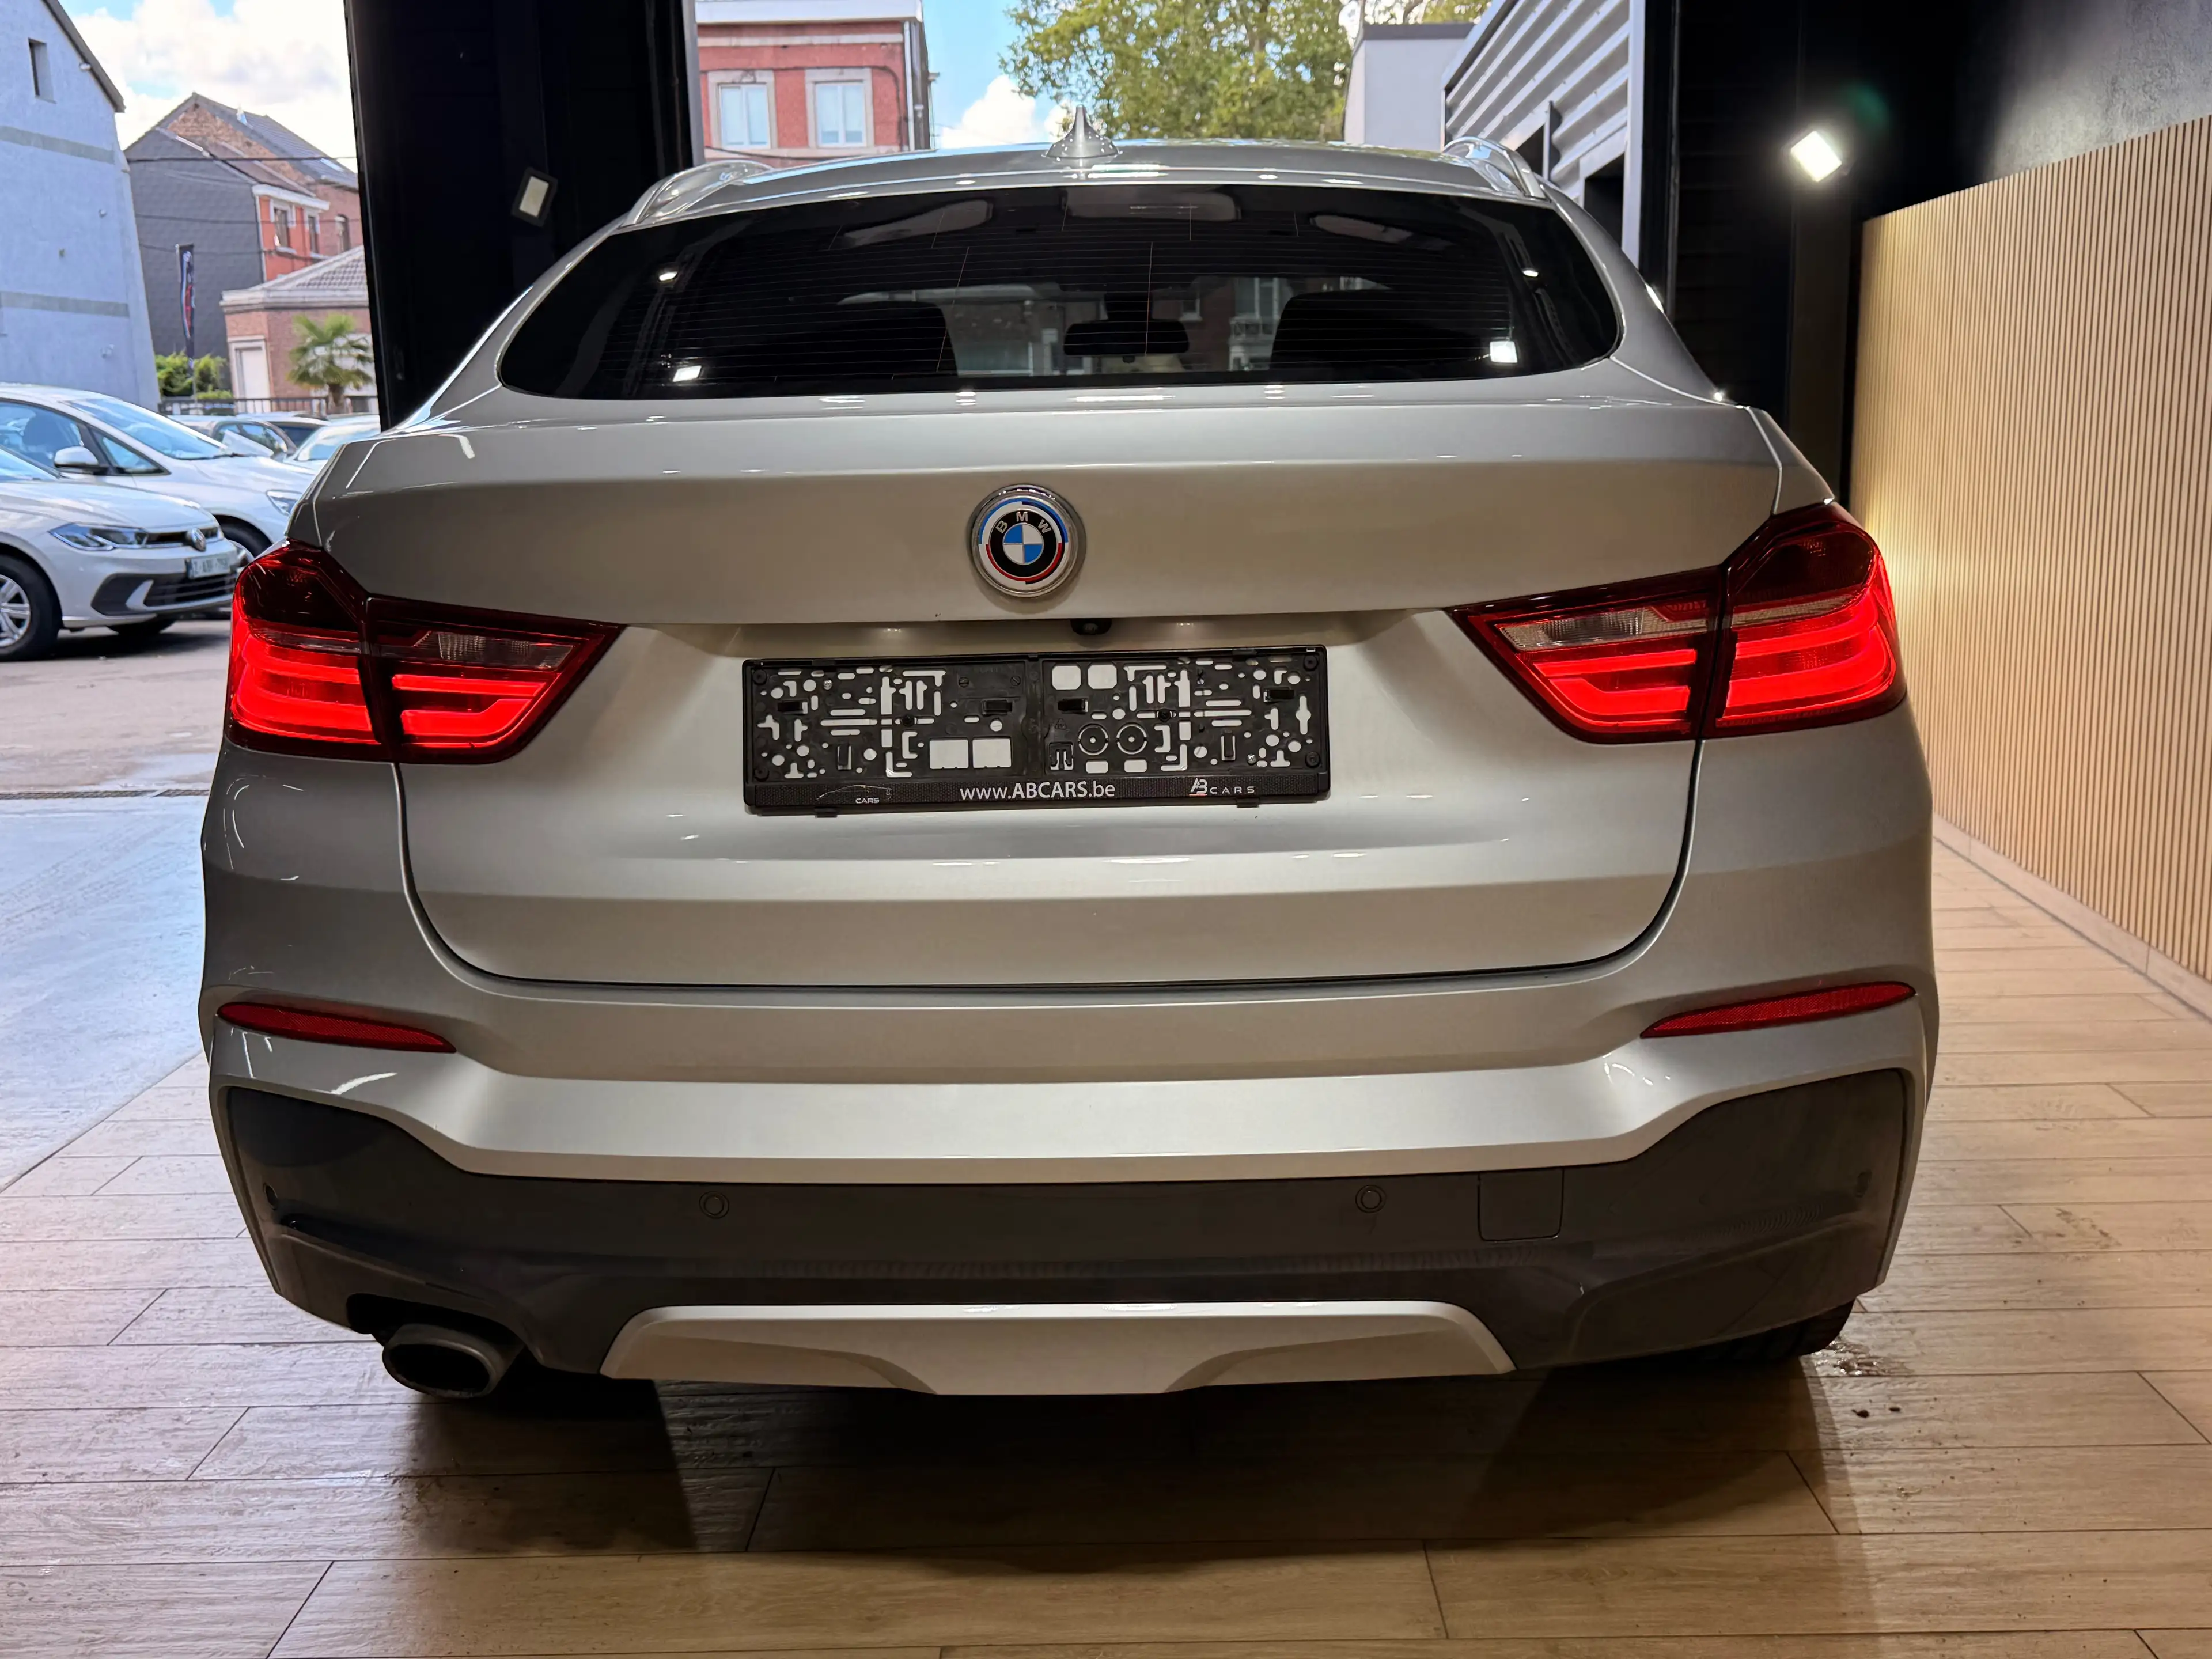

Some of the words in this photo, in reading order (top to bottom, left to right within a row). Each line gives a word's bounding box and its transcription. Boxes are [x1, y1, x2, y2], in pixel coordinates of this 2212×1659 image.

[995, 511, 1051, 534] BMW
[959, 780, 1116, 800] www.ABCARS.be
[1209, 786, 1255, 794] CARS
